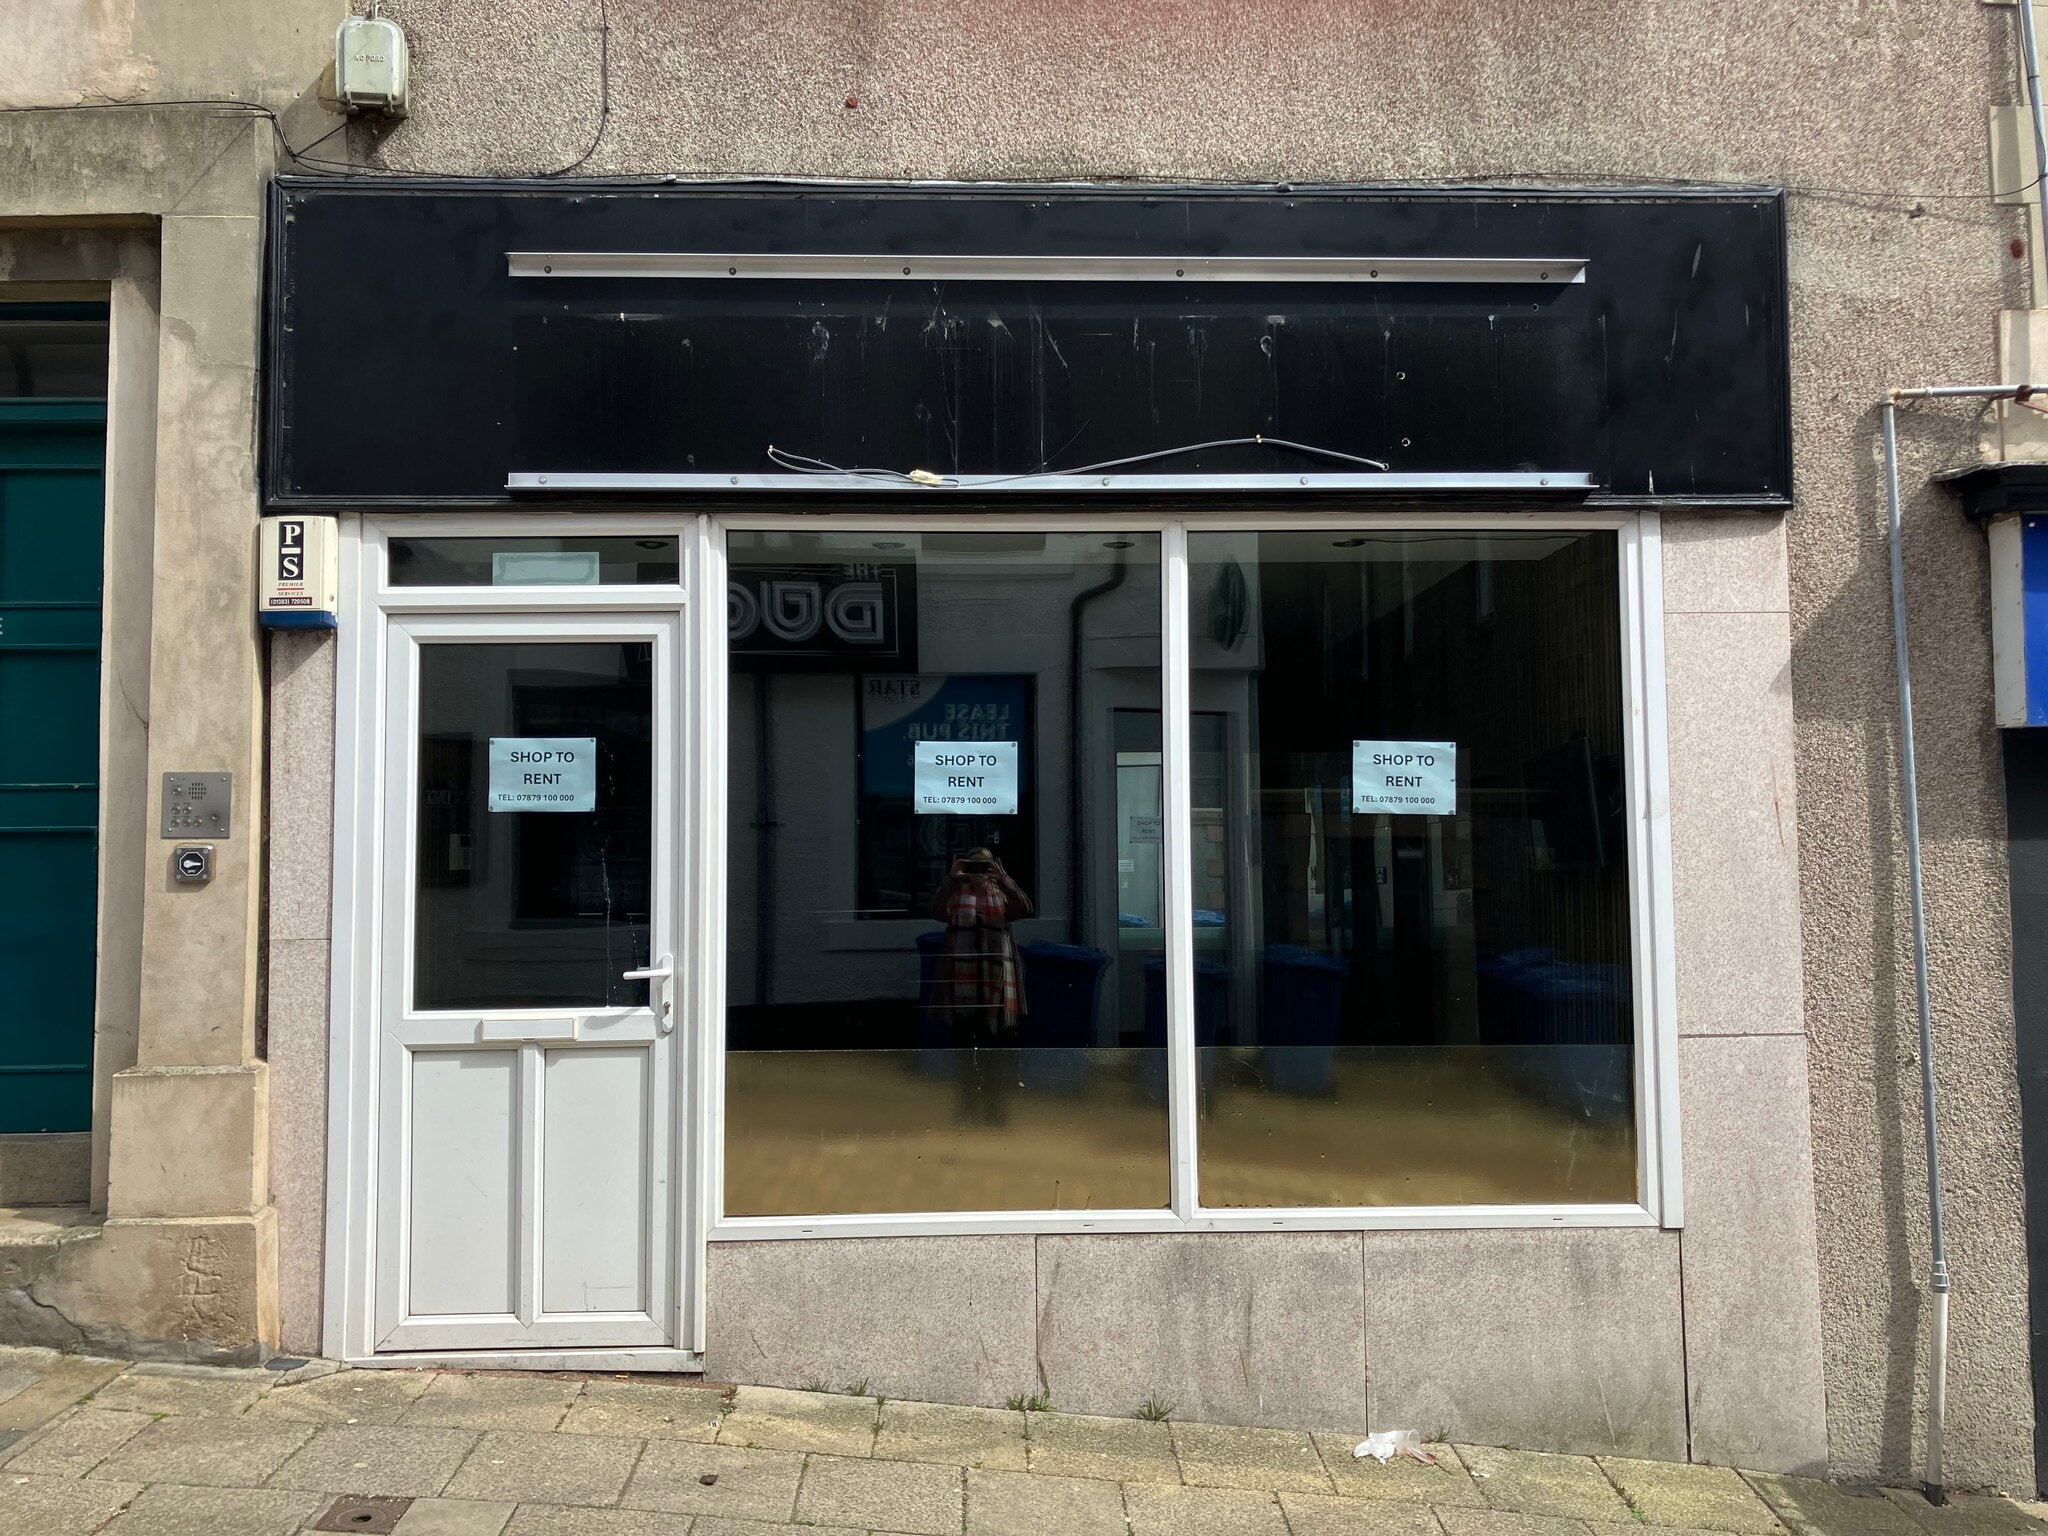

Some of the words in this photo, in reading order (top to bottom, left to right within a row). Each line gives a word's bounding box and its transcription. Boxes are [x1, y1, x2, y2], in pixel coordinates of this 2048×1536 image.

[283, 524, 301, 545] P
[282, 556, 299, 578] S
[510, 751, 552, 763] SHOP
[556, 751, 575, 763] TO
[935, 754, 976, 766] SHOP
[979, 755, 997, 767] TO
[1373, 754, 1413, 766] SHOP
[1416, 755, 1435, 767] TO
[523, 773, 562, 785] RENT
[948, 776, 985, 788] RENT
[1385, 775, 1423, 787] RENT
[498, 794, 515, 802] TEL:
[516, 794, 541, 802] 07879
[543, 794, 558, 802] 100
[559, 794, 575, 802] 000
[923, 796, 940, 804] TEL:
[941, 796, 965, 804] 07879
[1361, 795, 1378, 803] TEL:
[1379, 796, 1403, 804] 07879
[1405, 796, 1419, 804] 100
